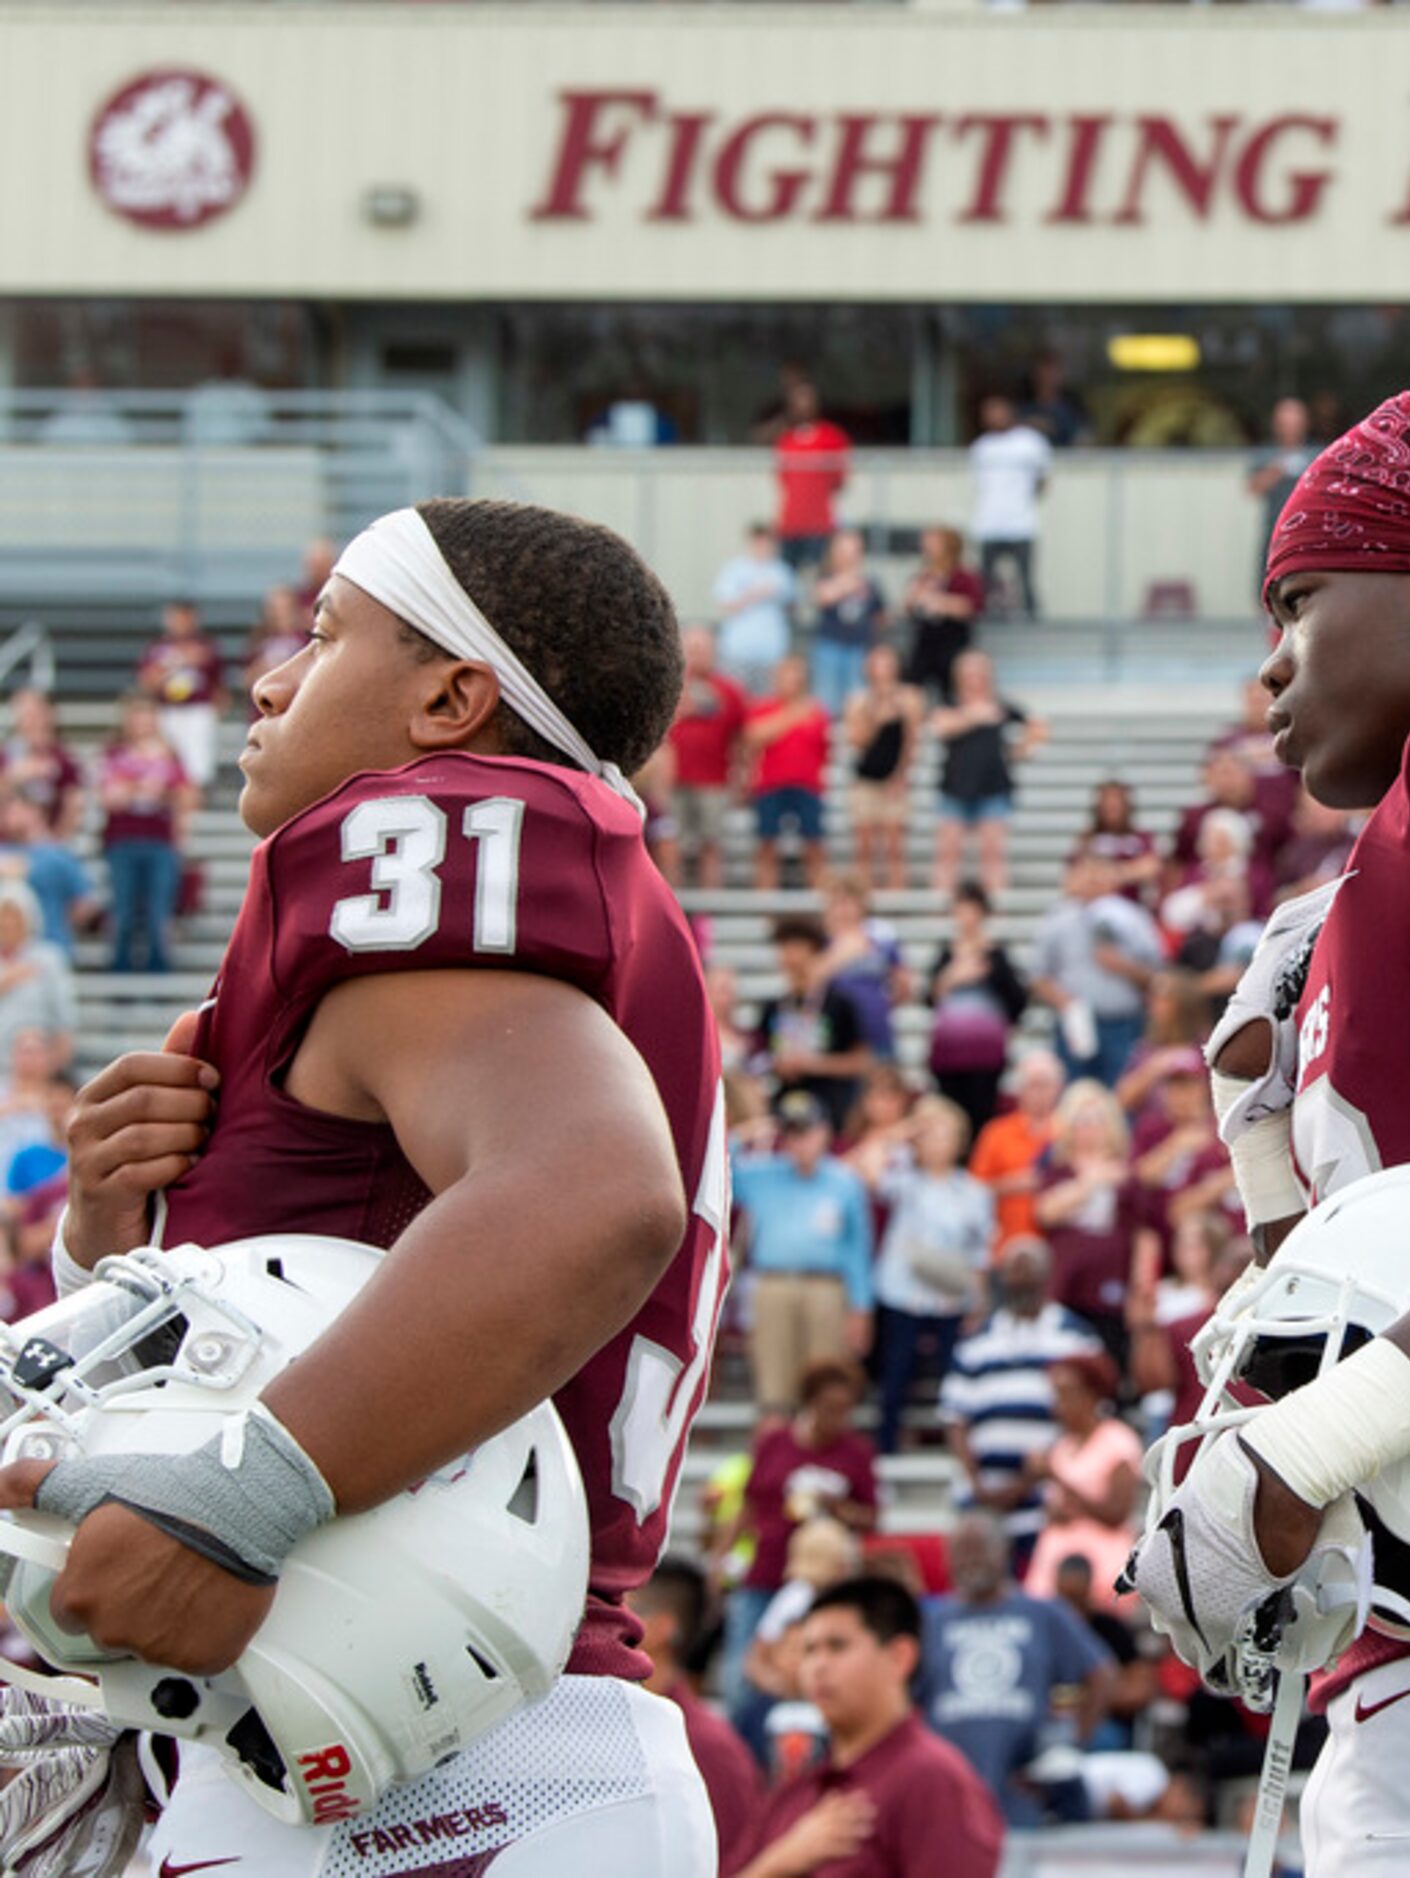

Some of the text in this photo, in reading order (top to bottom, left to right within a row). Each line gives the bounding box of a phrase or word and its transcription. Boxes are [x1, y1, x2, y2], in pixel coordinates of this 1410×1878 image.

[530, 88, 1339, 225] FIGHTING
[329, 795, 526, 954] 31
[350, 1801, 508, 1856] FARMERS
